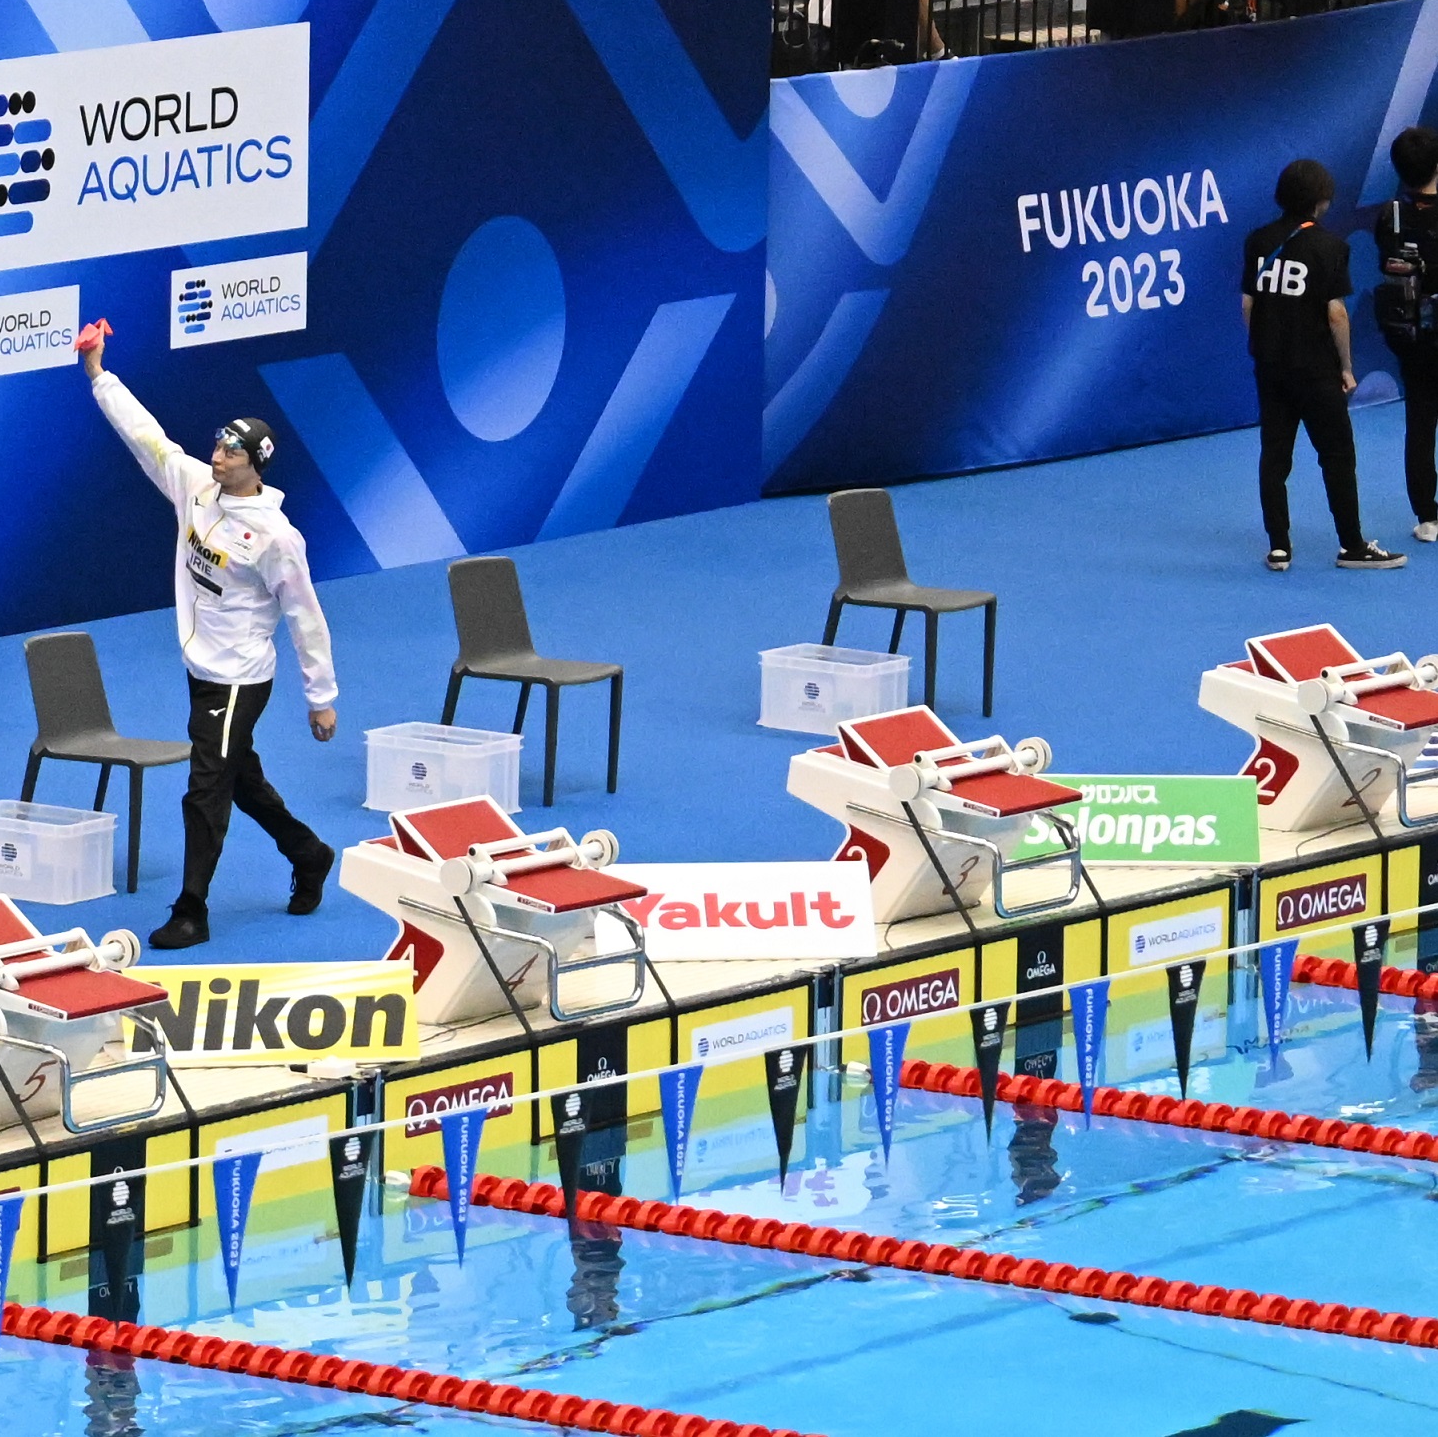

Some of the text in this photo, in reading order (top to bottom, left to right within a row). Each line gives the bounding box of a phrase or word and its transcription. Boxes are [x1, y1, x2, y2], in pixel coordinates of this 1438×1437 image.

[79, 86, 239, 146] WORLD
[77, 134, 293, 206] AQUATICS
[1017, 168, 1229, 253] FUKUOKA
[222, 274, 282, 298] WORLD
[1081, 248, 1186, 318] 2023
[1256, 256, 1310, 297] HB
[221, 291, 302, 320] AQUATICS
[187, 529, 222, 566] Nikon
[190, 554, 213, 578] IRIE
[1254, 757, 1277, 797] 2
[622, 890, 856, 931] Yakult
[1299, 880, 1366, 920] OMEGA
[1148, 922, 1216, 948] WORLD AQUATICS
[1026, 963, 1056, 980] OMEGA
[132, 976, 407, 1053] Nikon
[885, 975, 958, 1018] OMEGA
[712, 1023, 787, 1050] WORLD AQUATICS
[884, 1029, 894, 1095] FUKUOKA
[460, 1116, 470, 1185] FUKUOKA
[231, 1158, 242, 1229] FUKUOKA
